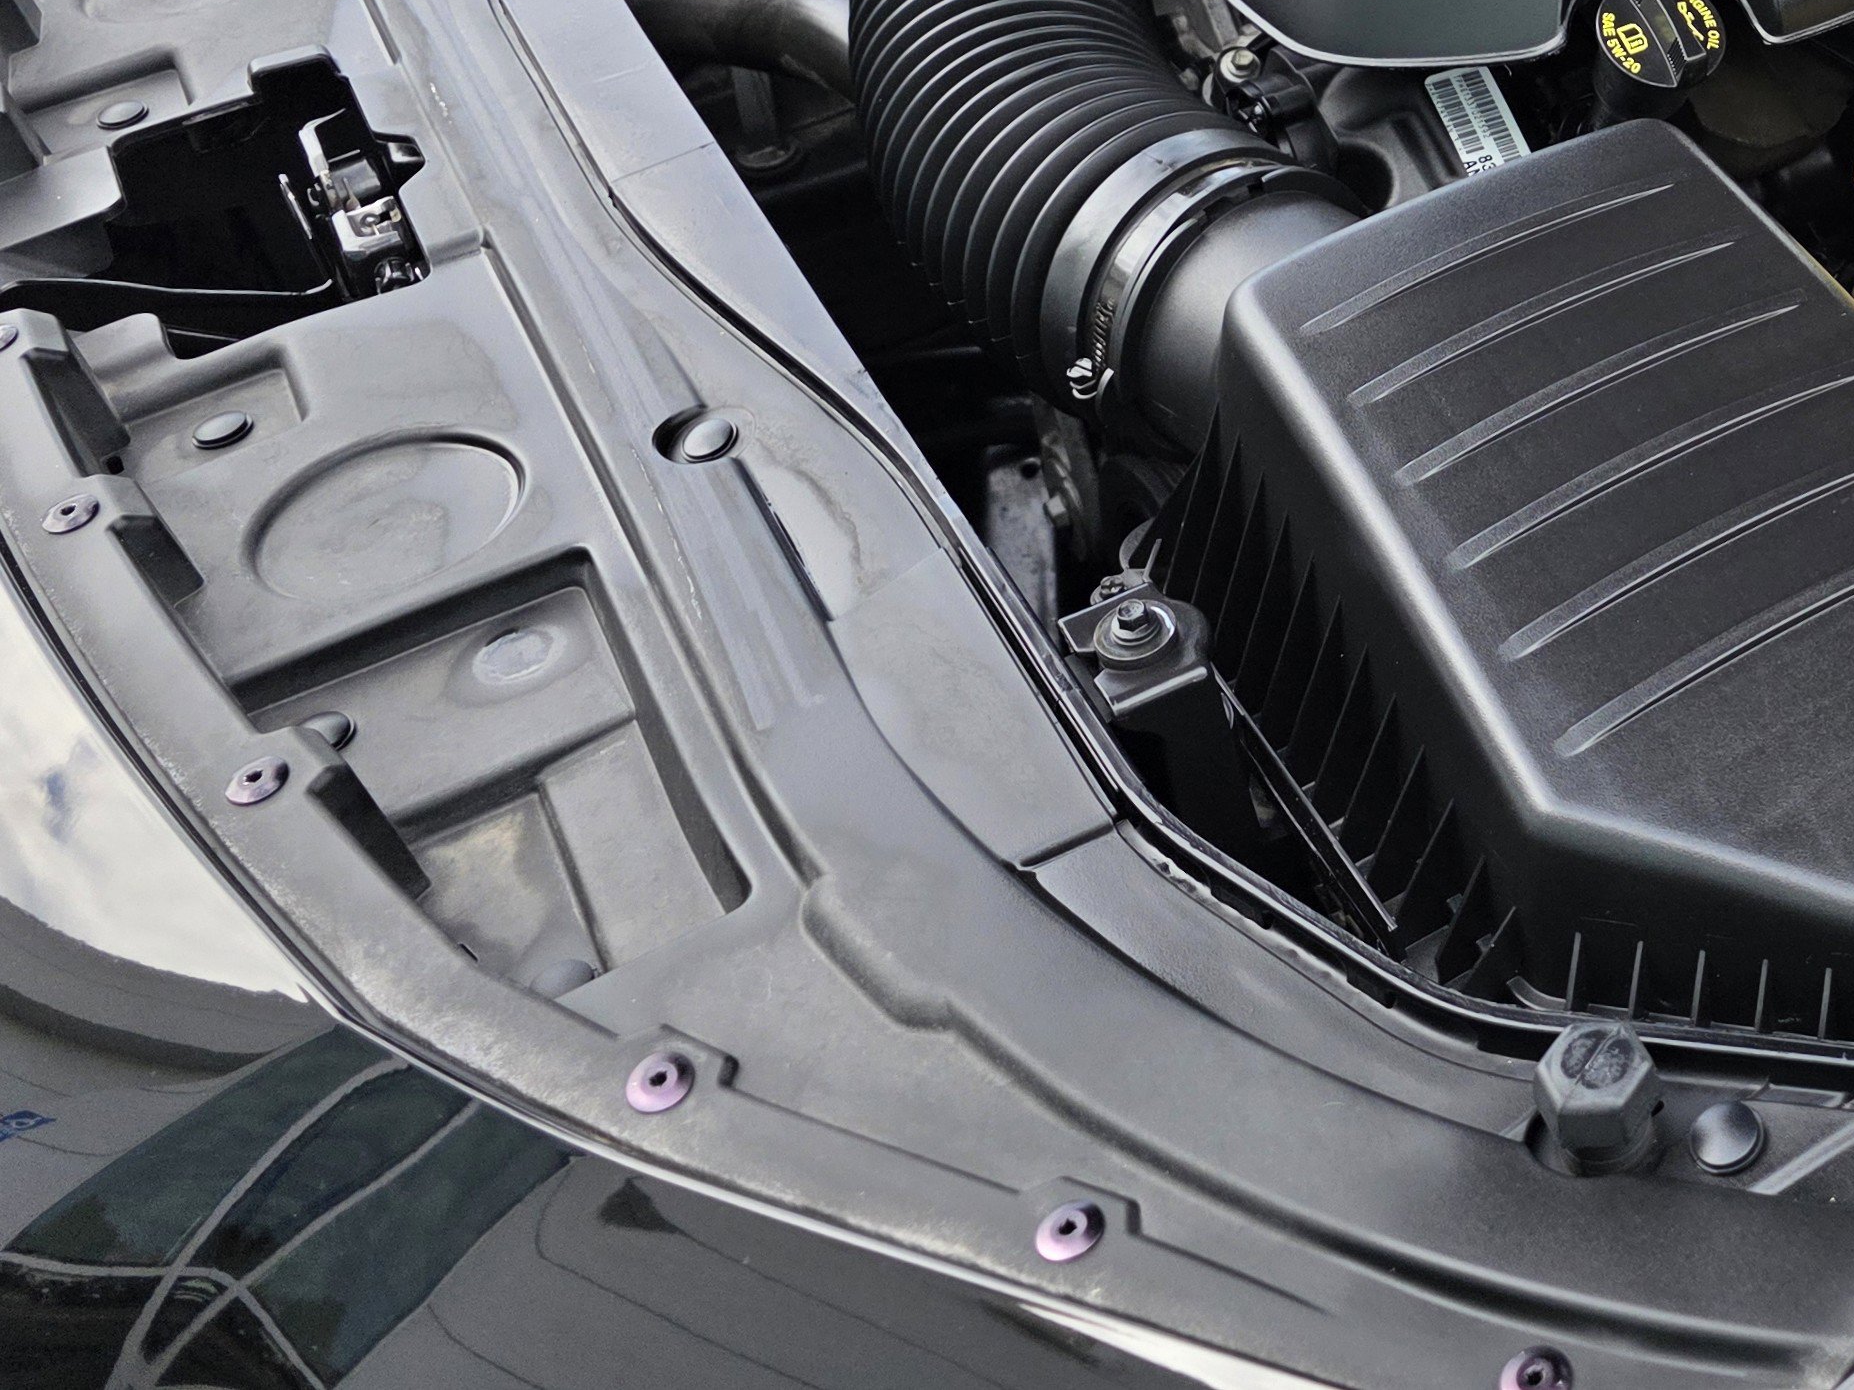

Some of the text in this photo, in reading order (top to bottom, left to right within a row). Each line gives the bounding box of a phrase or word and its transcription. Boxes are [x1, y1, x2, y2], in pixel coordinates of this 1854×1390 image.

[1602, 12, 1642, 74] SAE 5W-20
[1706, 29, 1721, 50] OIL
